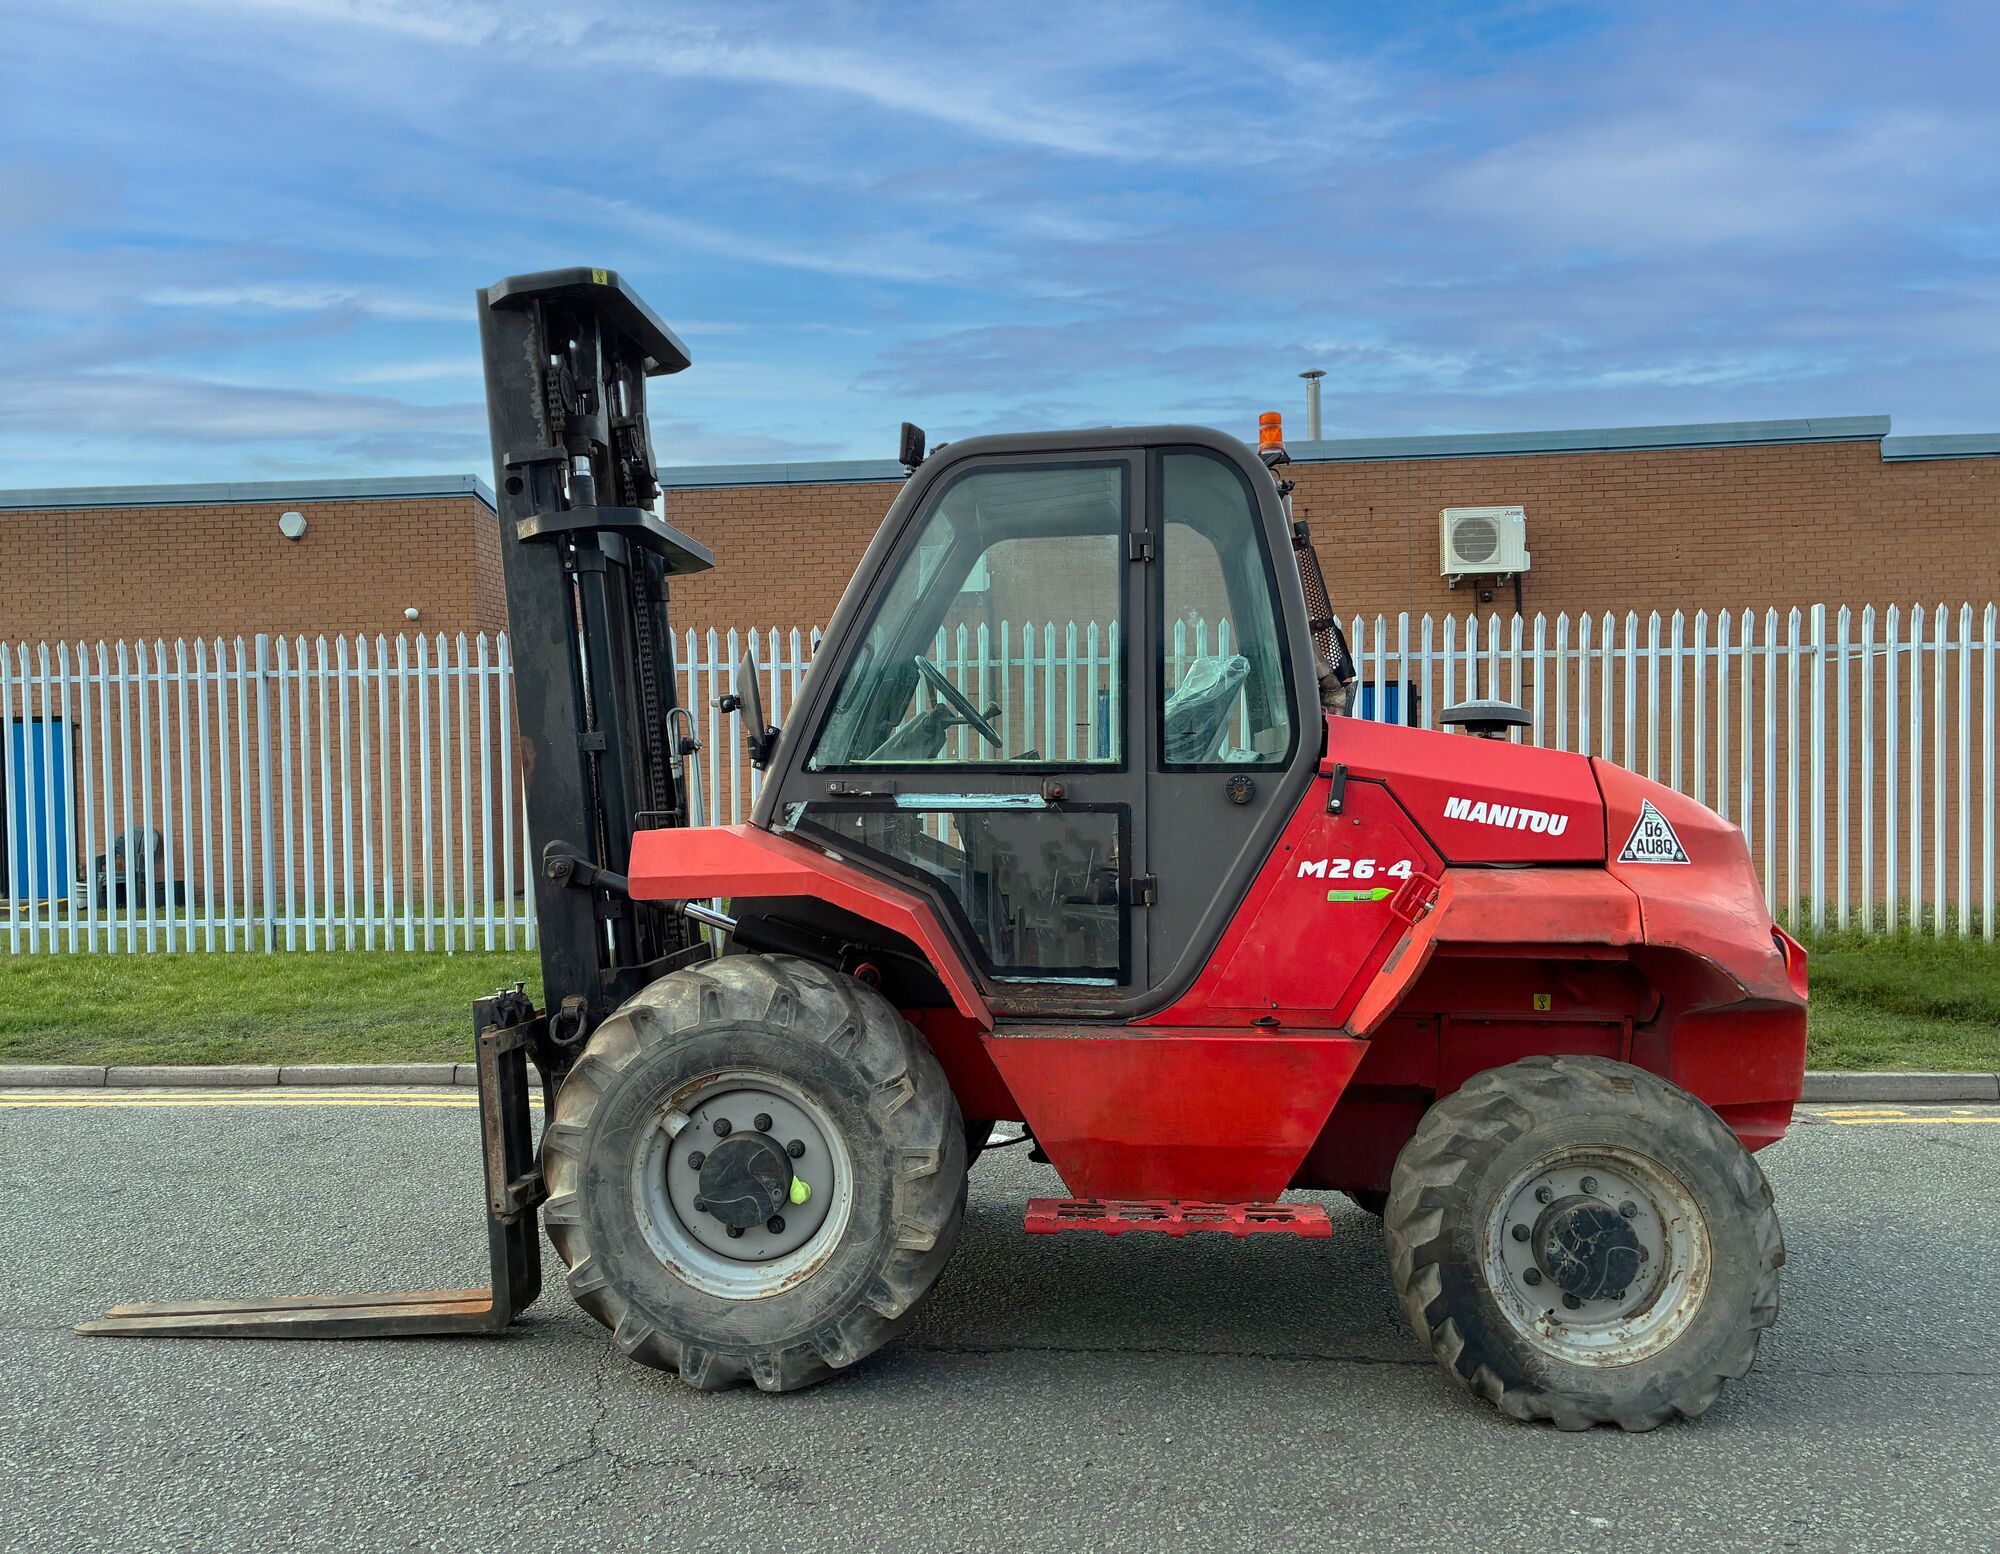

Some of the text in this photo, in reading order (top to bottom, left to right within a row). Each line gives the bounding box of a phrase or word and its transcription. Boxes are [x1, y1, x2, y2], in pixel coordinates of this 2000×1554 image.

[1443, 796, 1569, 836] MANITOU
[1636, 838, 1673, 855] AU8Q
[1297, 858, 1413, 880] M26-4
